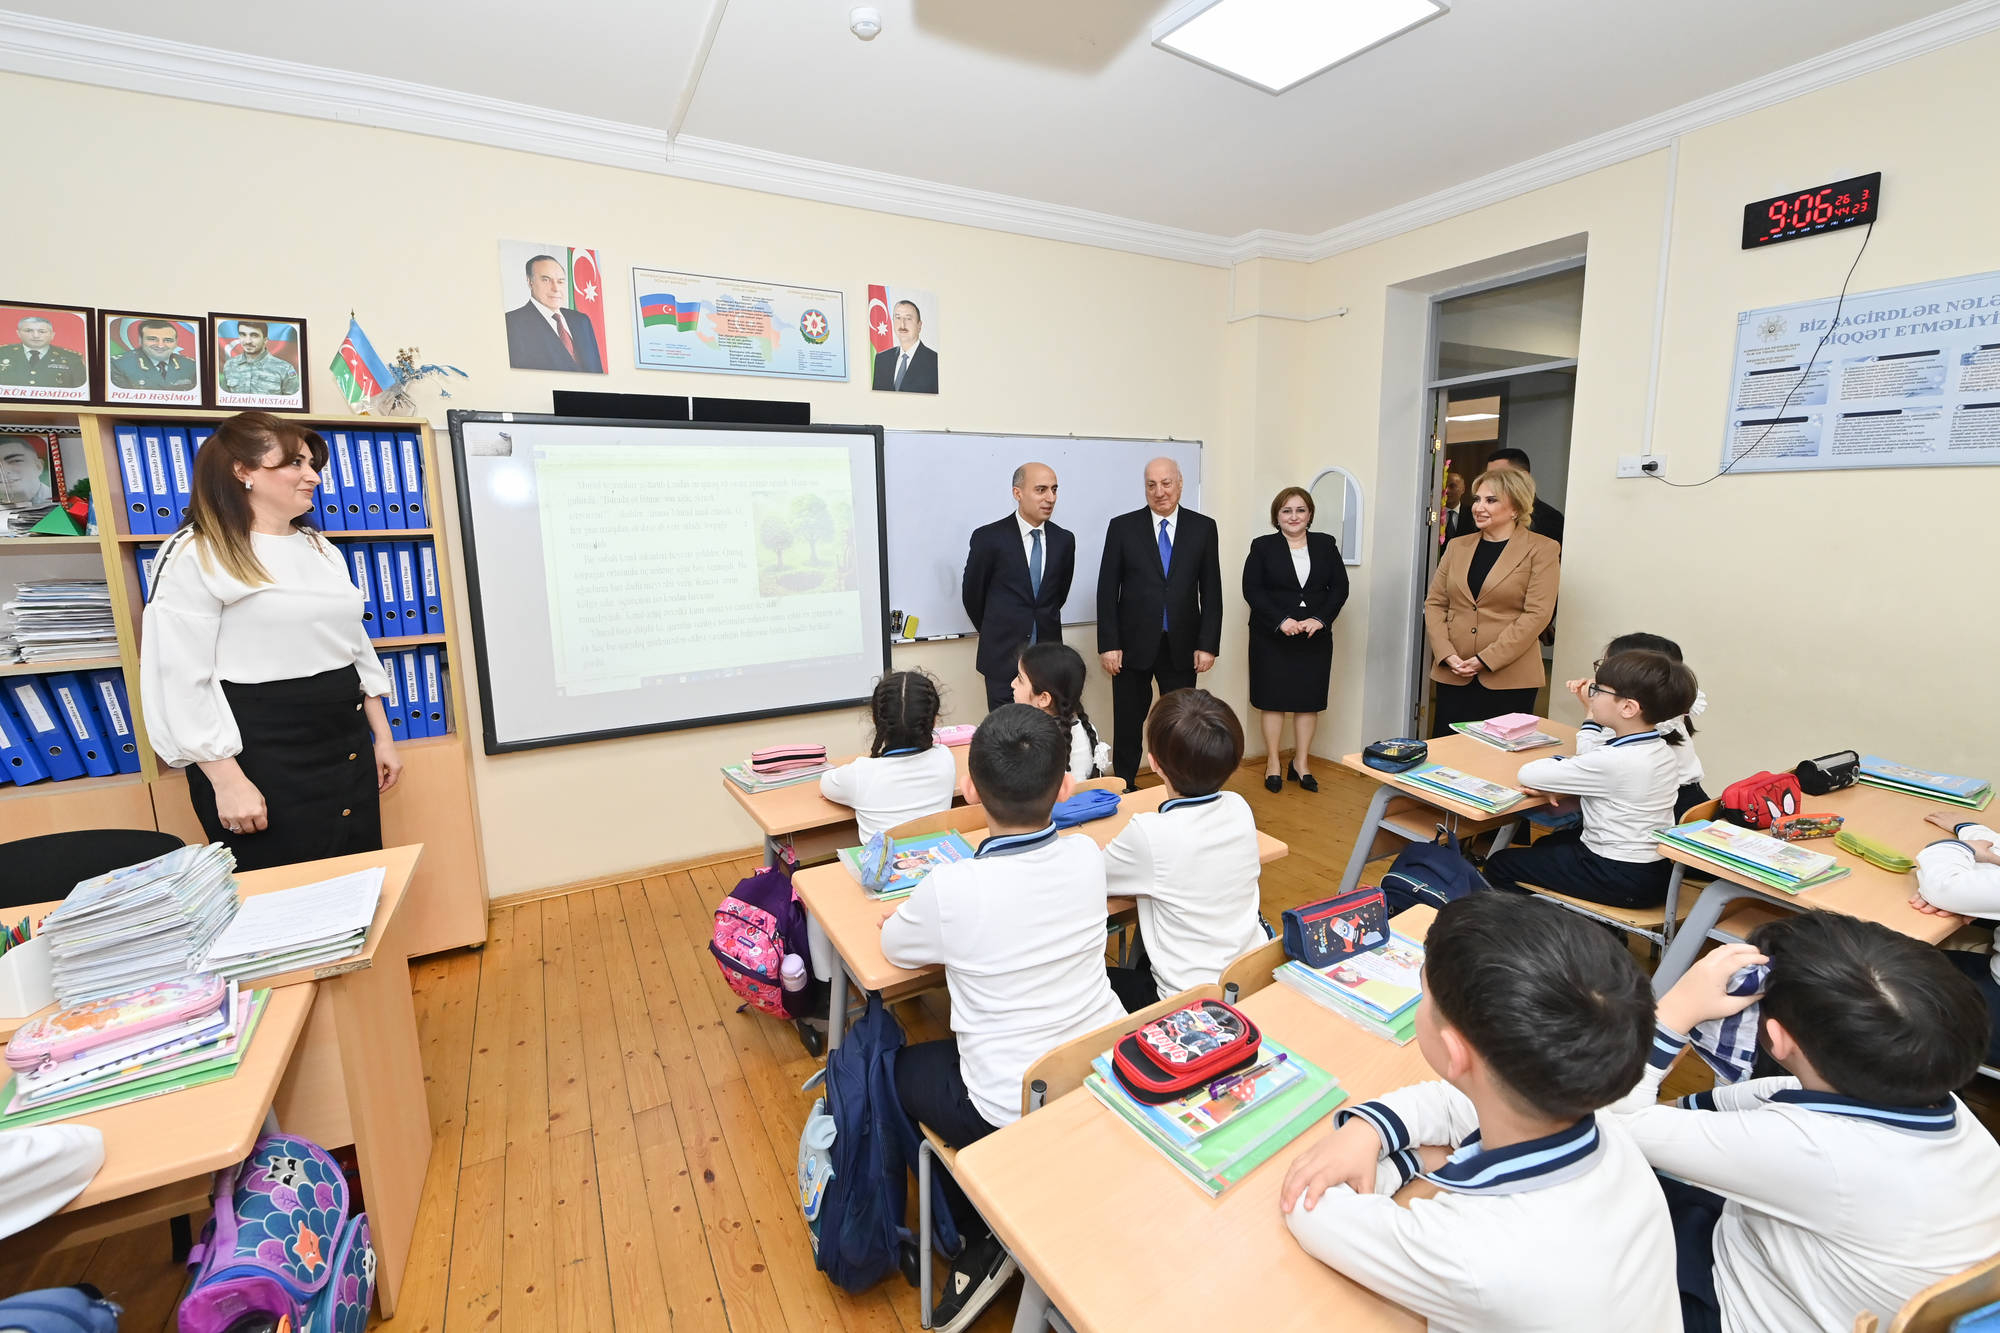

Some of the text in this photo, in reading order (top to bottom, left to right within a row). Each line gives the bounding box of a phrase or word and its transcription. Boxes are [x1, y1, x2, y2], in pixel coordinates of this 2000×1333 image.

[1835, 189, 1870, 206] 26 3
[1769, 189, 1833, 234] 9:06
[1834, 202, 1868, 216] 44 23
[1800, 318, 1827, 333] BİZ
[1818, 326, 1890, 347] DİQQƏT
[30, 389, 84, 399] HƏMİDOV
[112, 391, 197, 402] POLAD HƏŞİMOV
[1142, 1022, 1188, 1060] RACING
